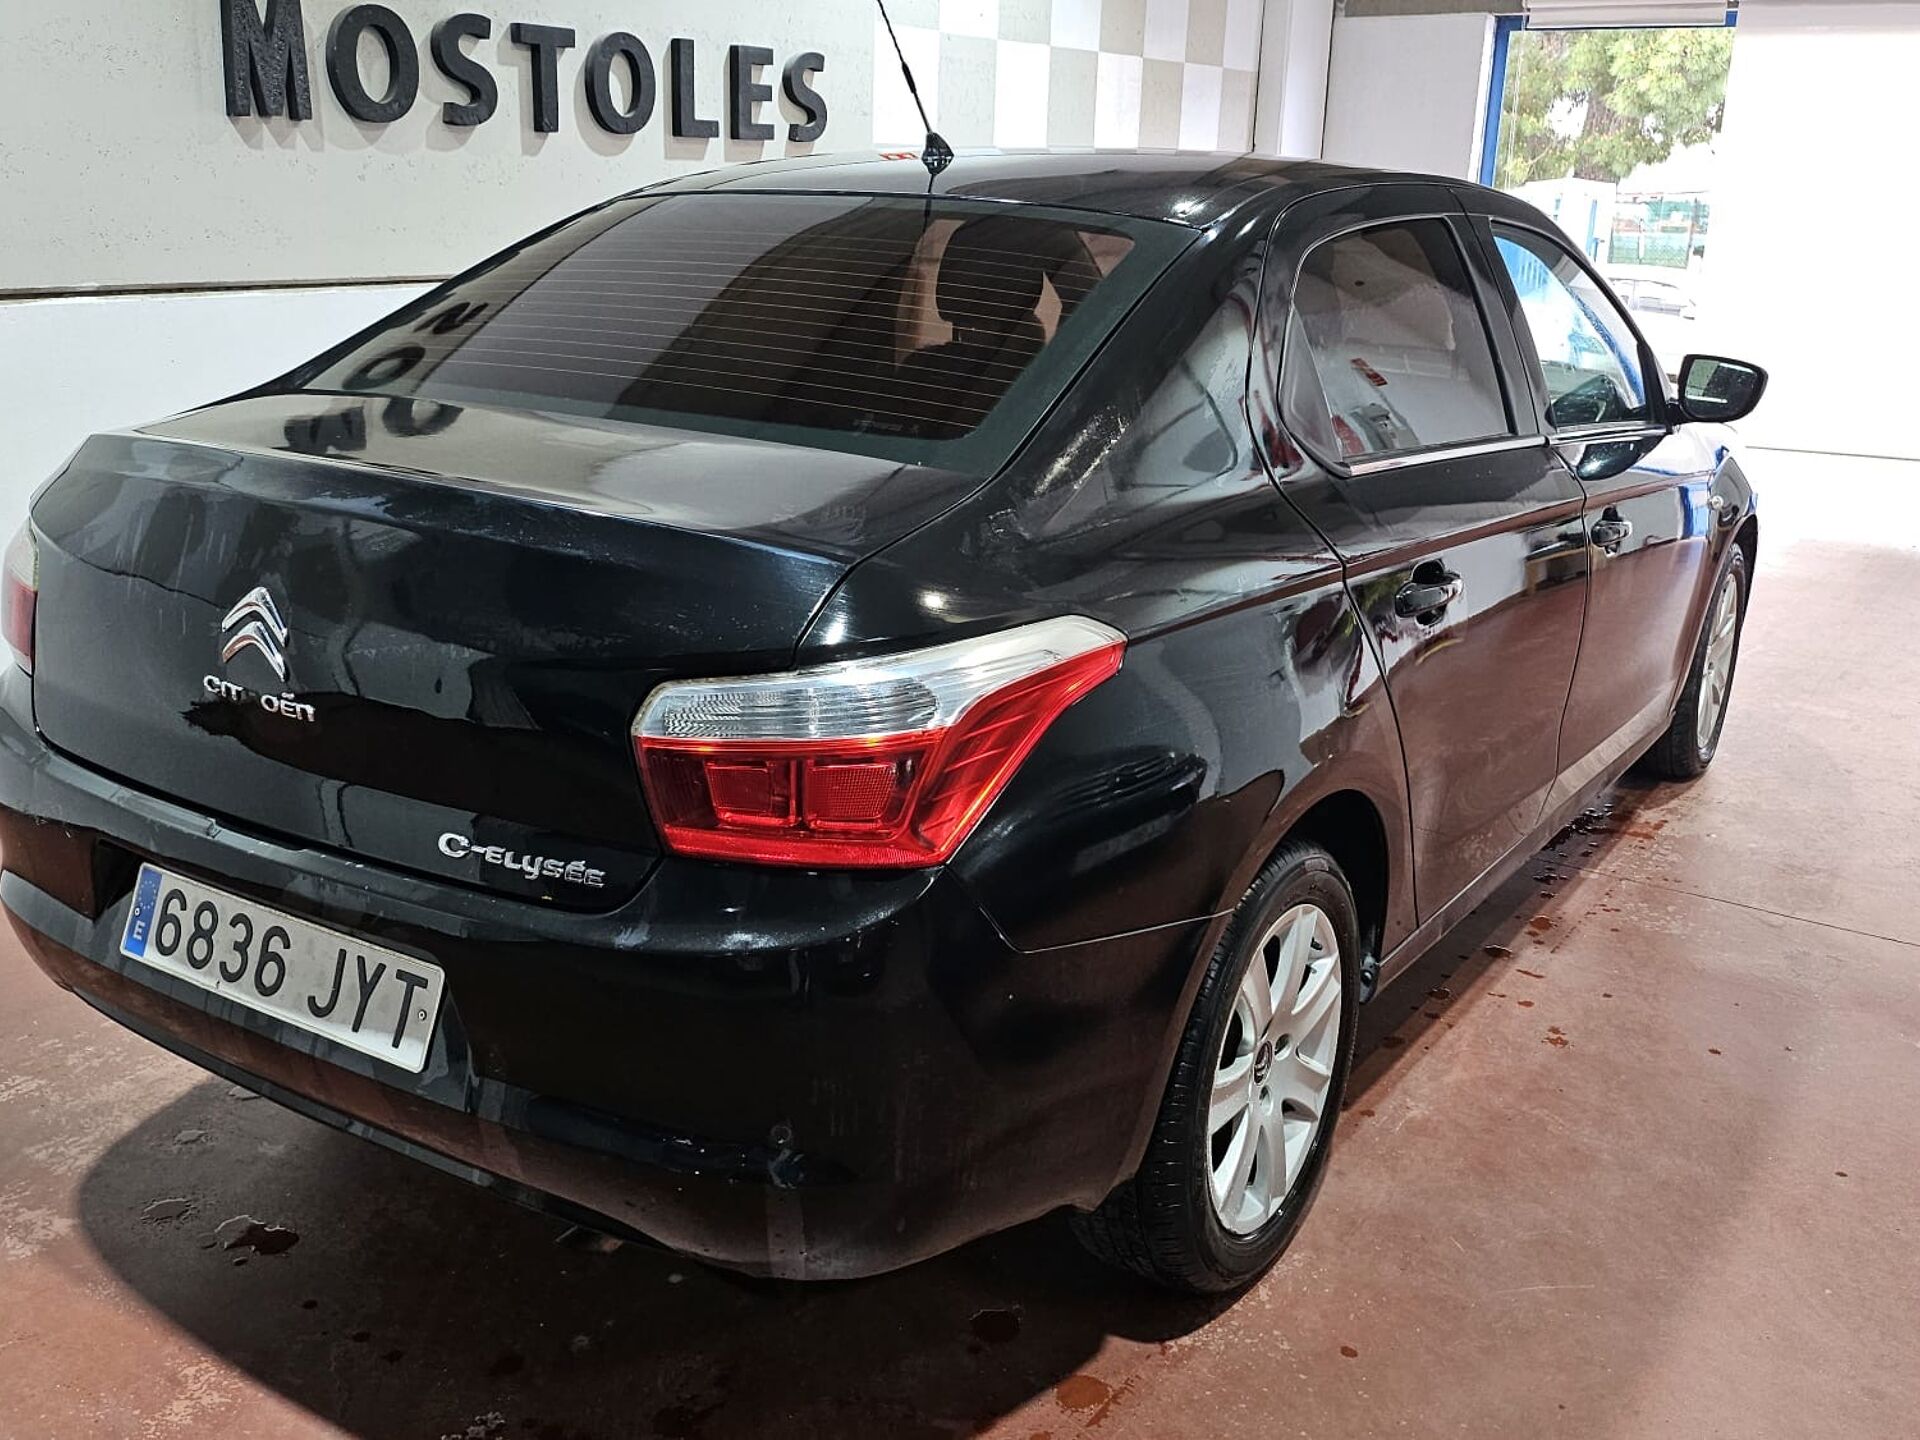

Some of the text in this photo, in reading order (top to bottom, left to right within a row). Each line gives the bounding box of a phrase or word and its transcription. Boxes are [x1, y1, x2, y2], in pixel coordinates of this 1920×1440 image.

[220, 0, 827, 142] MOSTOLES
[132, 919, 146, 941] E
[154, 888, 429, 1049] 6836 JYT
